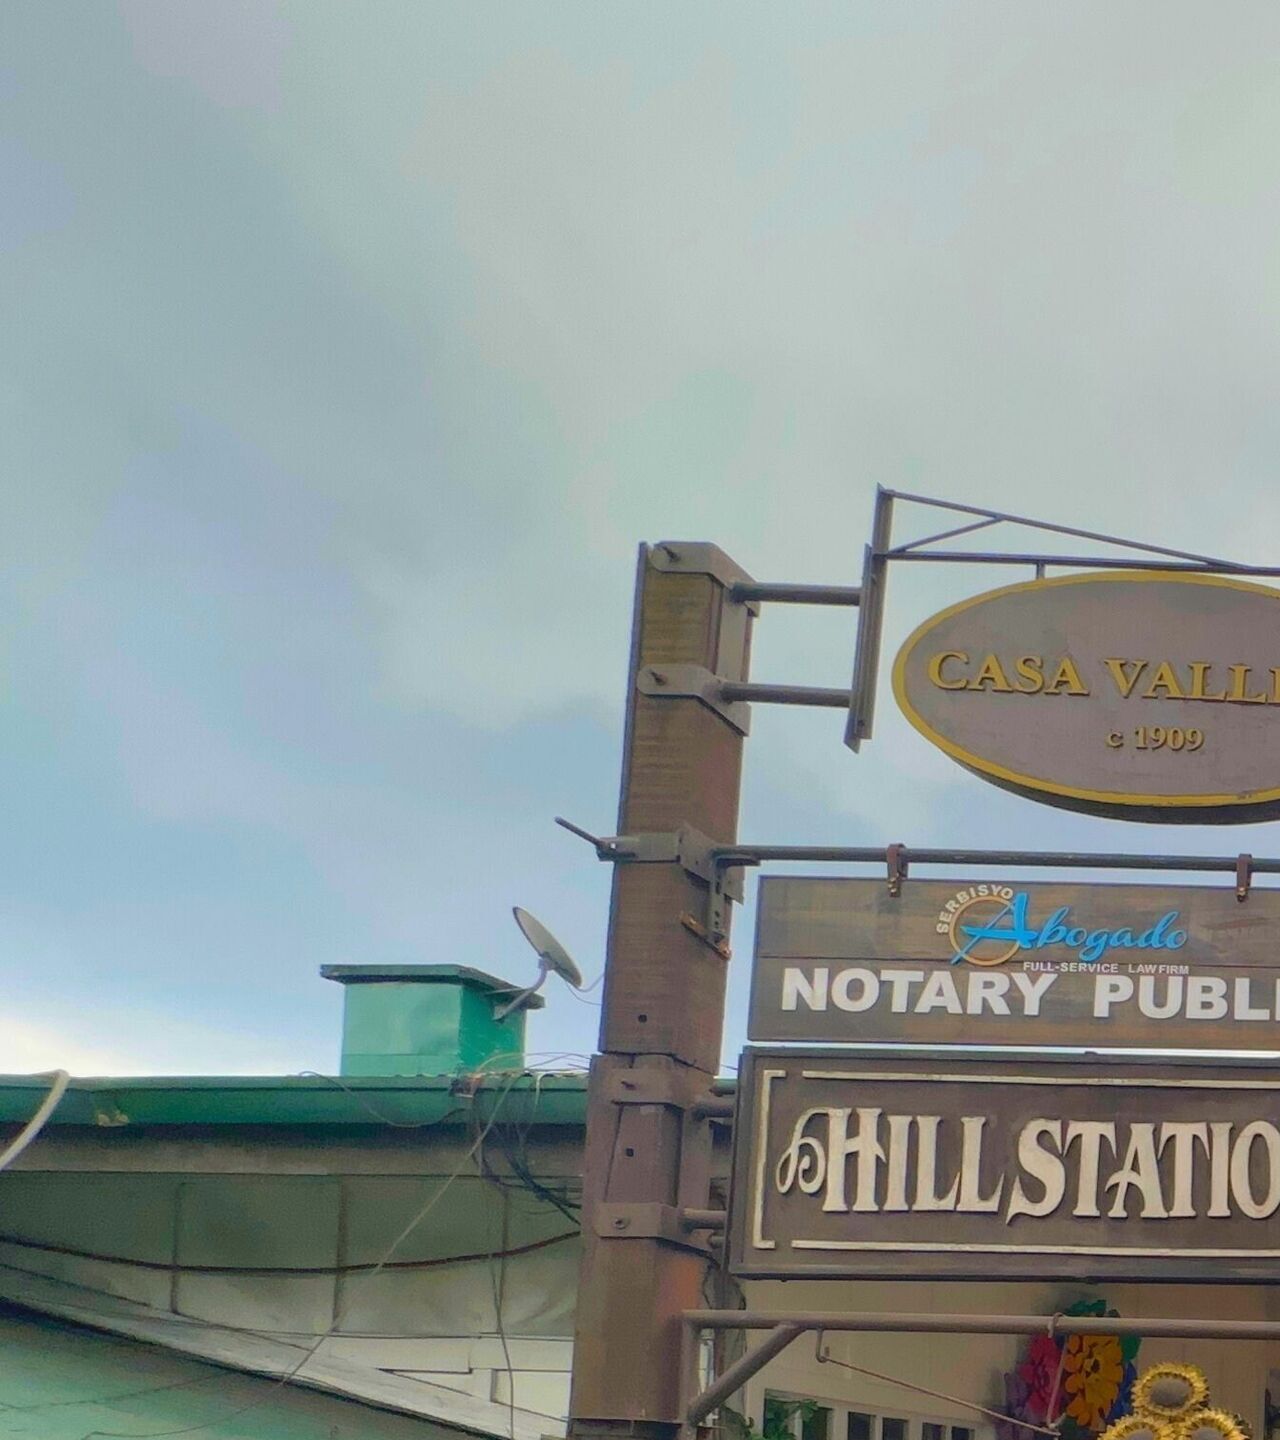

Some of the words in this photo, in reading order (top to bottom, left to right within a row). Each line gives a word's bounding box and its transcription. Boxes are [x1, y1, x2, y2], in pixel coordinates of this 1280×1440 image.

[927, 650, 1089, 696] CASA
[1105, 730, 1124, 749] c
[1134, 724, 1205, 752] 1909
[936, 884, 1014, 934] SERBISYO
[950, 892, 1189, 966] Abogado
[780, 966, 1058, 1017] NOTARY
[1023, 961, 1119, 974] FULL-SERVICE
[1128, 963, 1158, 974] LAW
[1159, 964, 1189, 975] FIRM
[776, 1107, 1004, 1213] HILL
